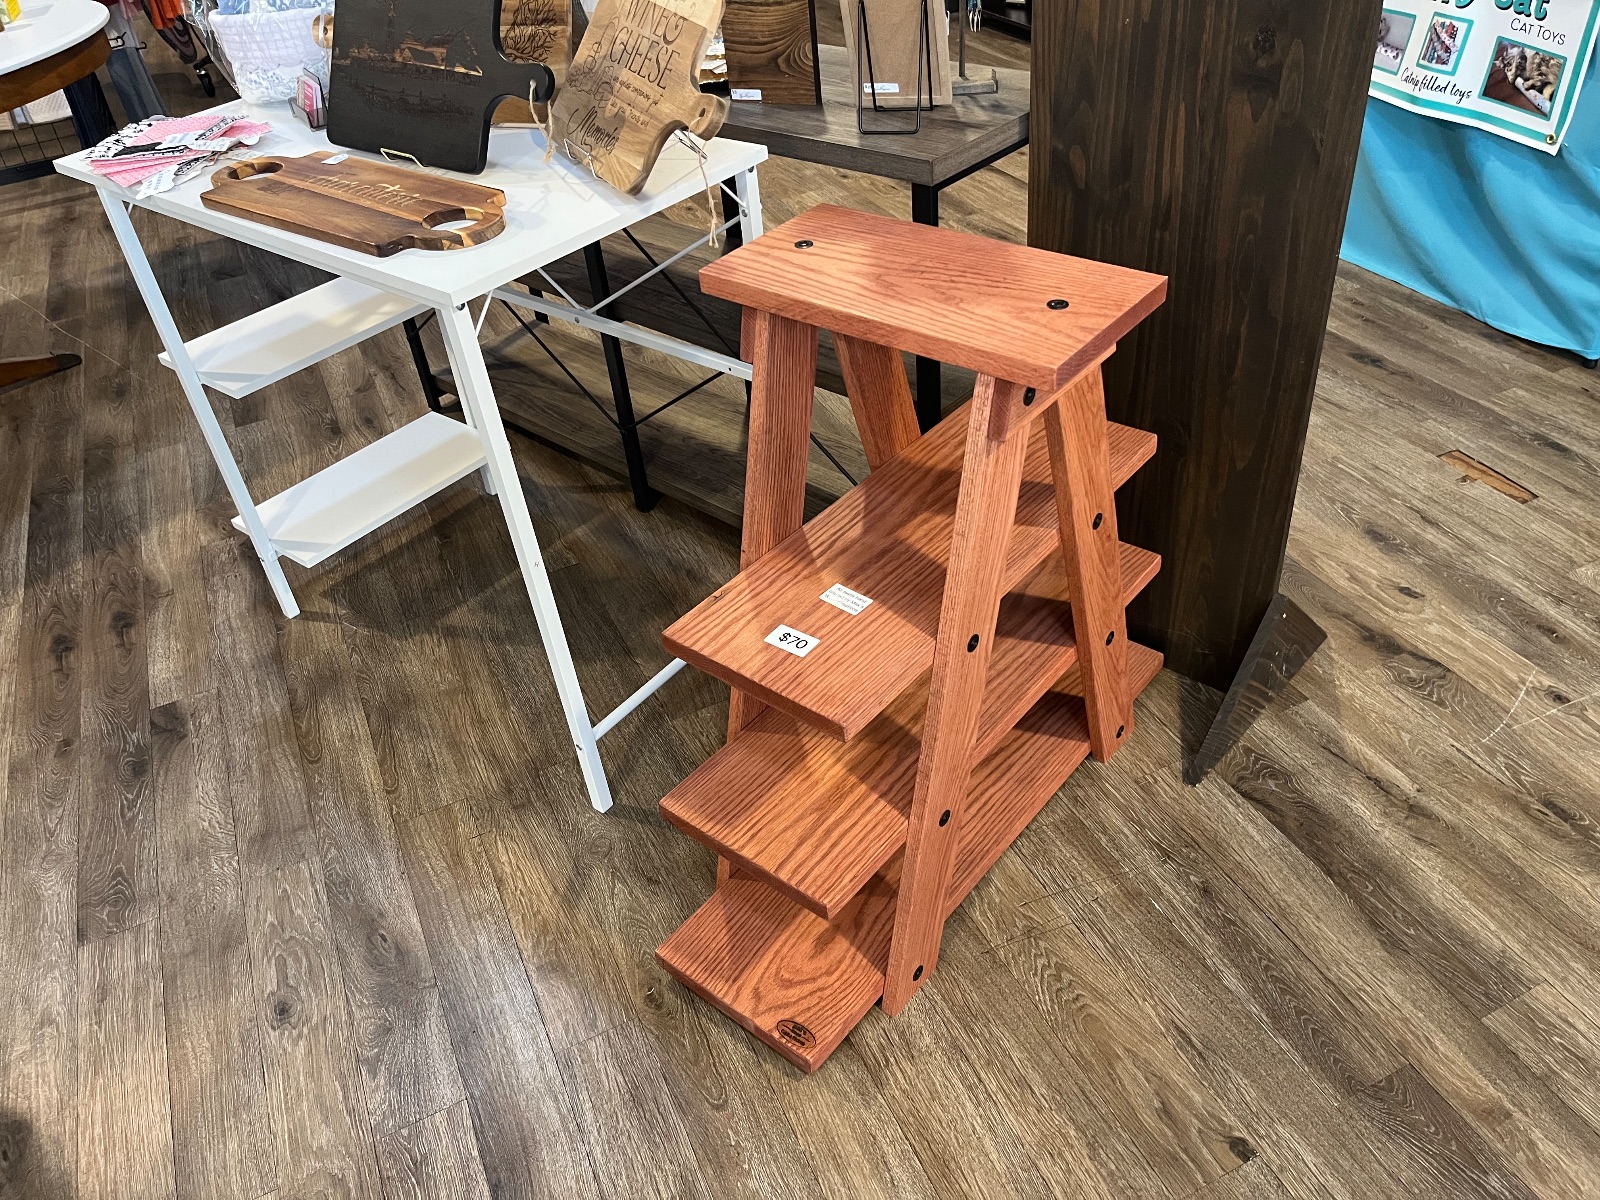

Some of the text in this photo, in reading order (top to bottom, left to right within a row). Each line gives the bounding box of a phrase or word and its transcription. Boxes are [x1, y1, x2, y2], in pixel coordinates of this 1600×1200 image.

[1510, 17, 1567, 46] CAT TOYS
[609, 26, 681, 90] CHEESE
[1400, 67, 1473, 104] Catnip filled toys
[778, 632, 809, 649] $70
